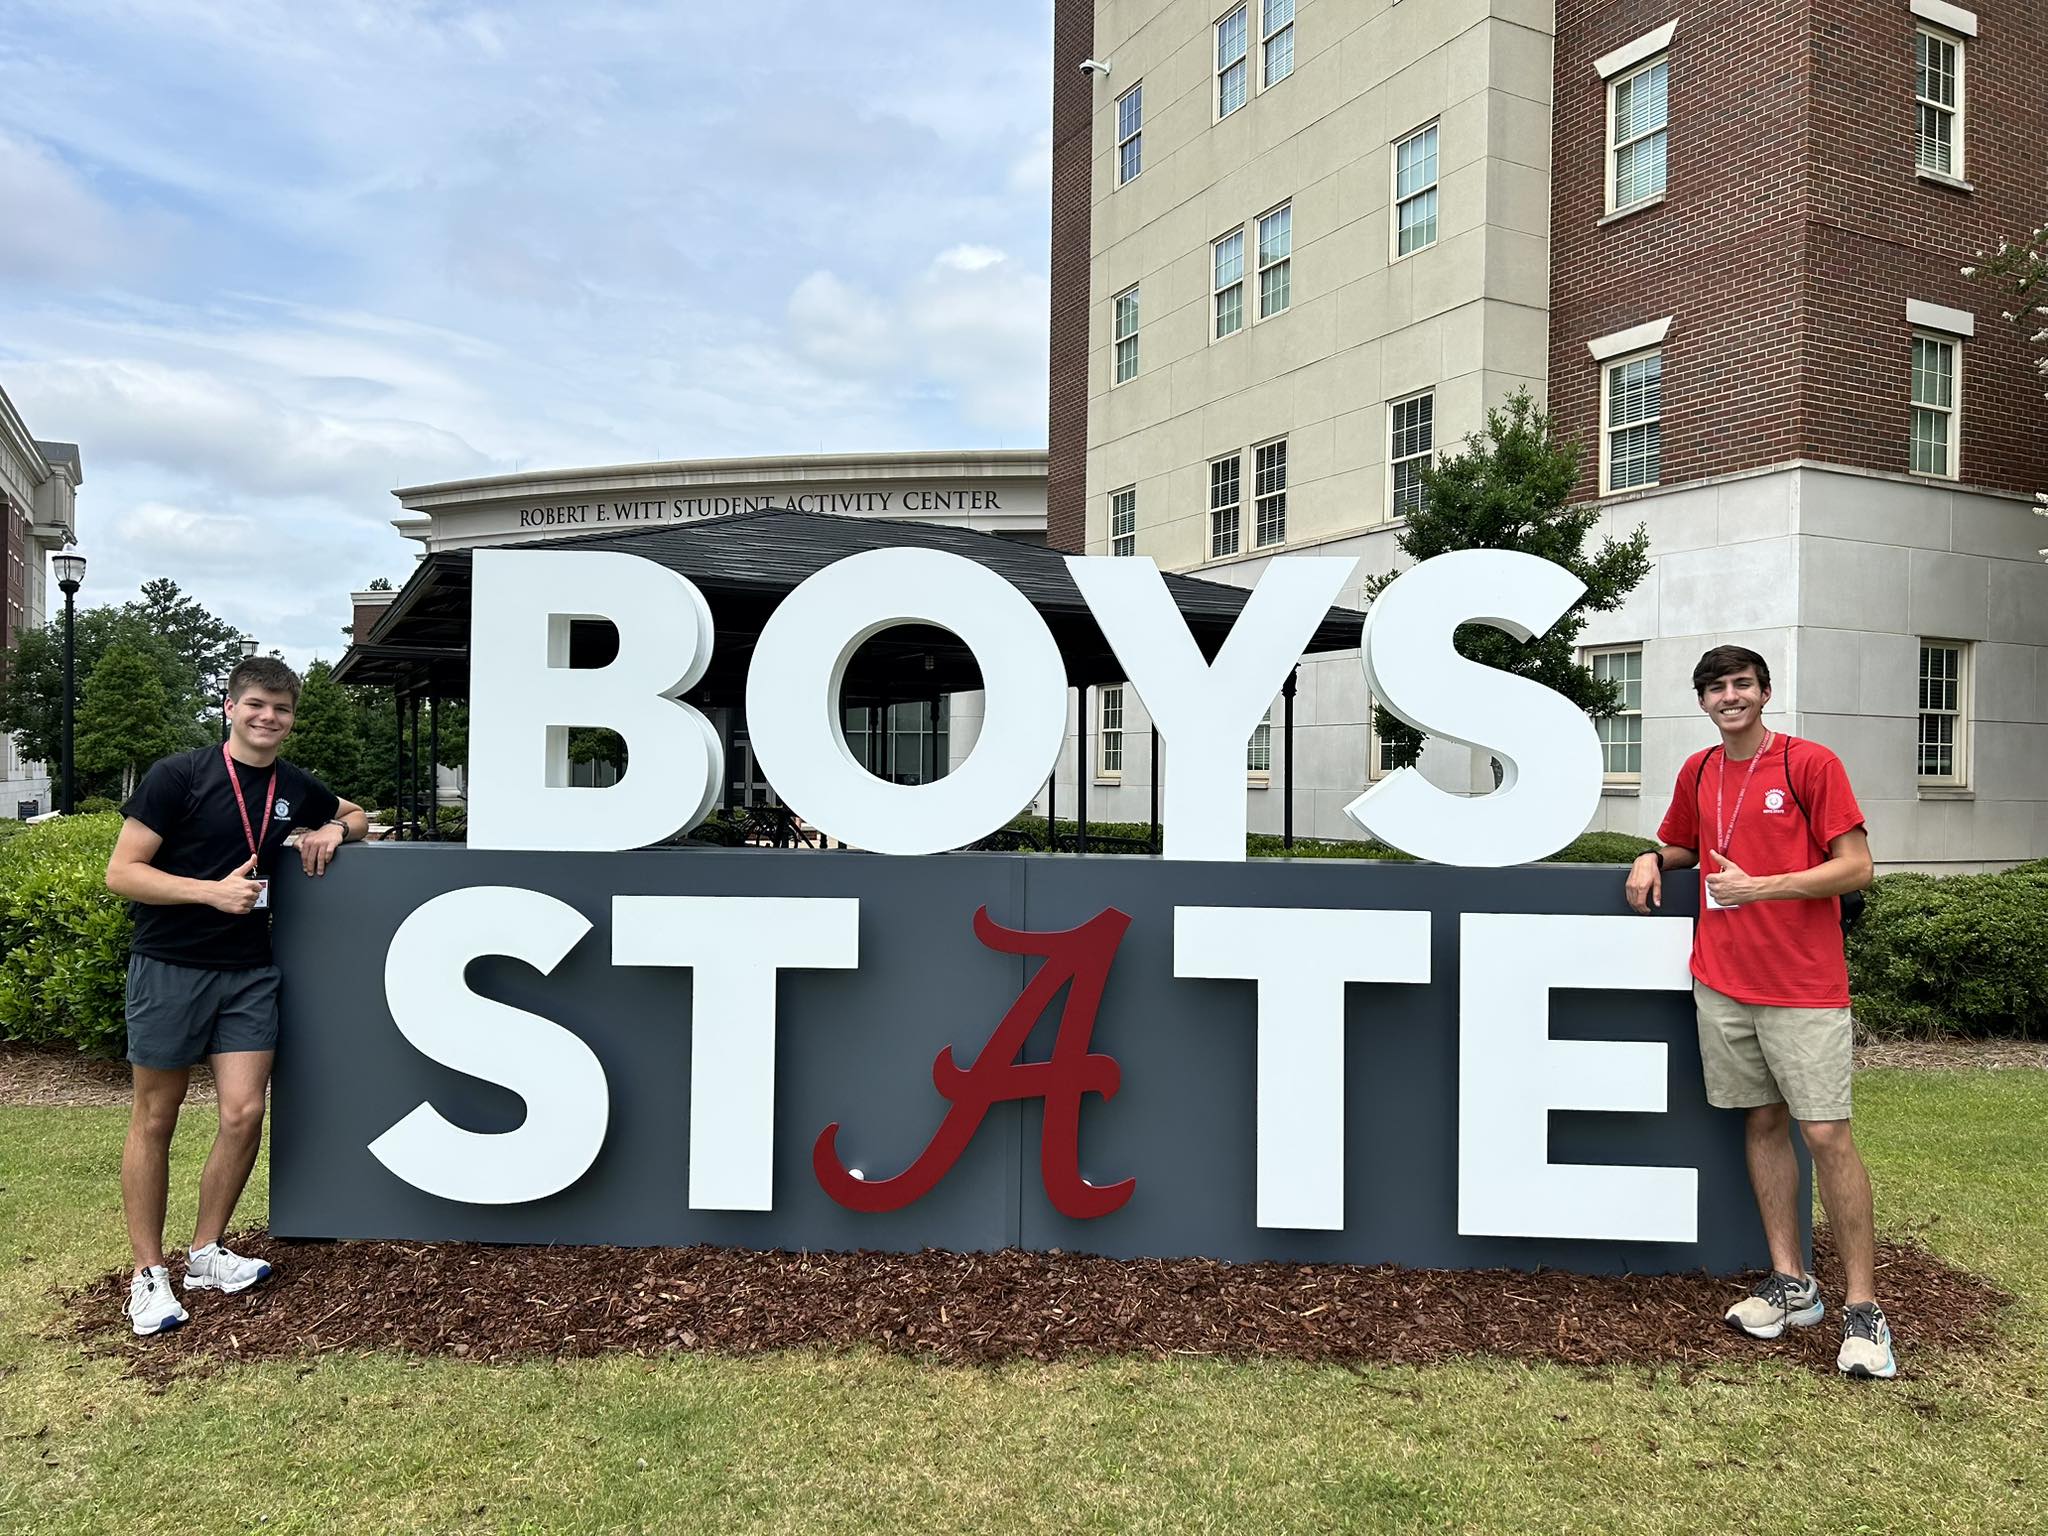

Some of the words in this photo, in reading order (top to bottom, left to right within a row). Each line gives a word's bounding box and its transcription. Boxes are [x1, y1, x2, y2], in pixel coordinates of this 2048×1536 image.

[520, 505, 589, 527] ROBERT
[596, 503, 610, 521] E.
[614, 501, 666, 520] WITT
[673, 496, 775, 518] STUDENT
[785, 492, 893, 513] ACTIVITY
[903, 490, 1001, 511] CENTER
[467, 546, 1604, 868] BOYS
[368, 885, 1699, 1244] STATE
